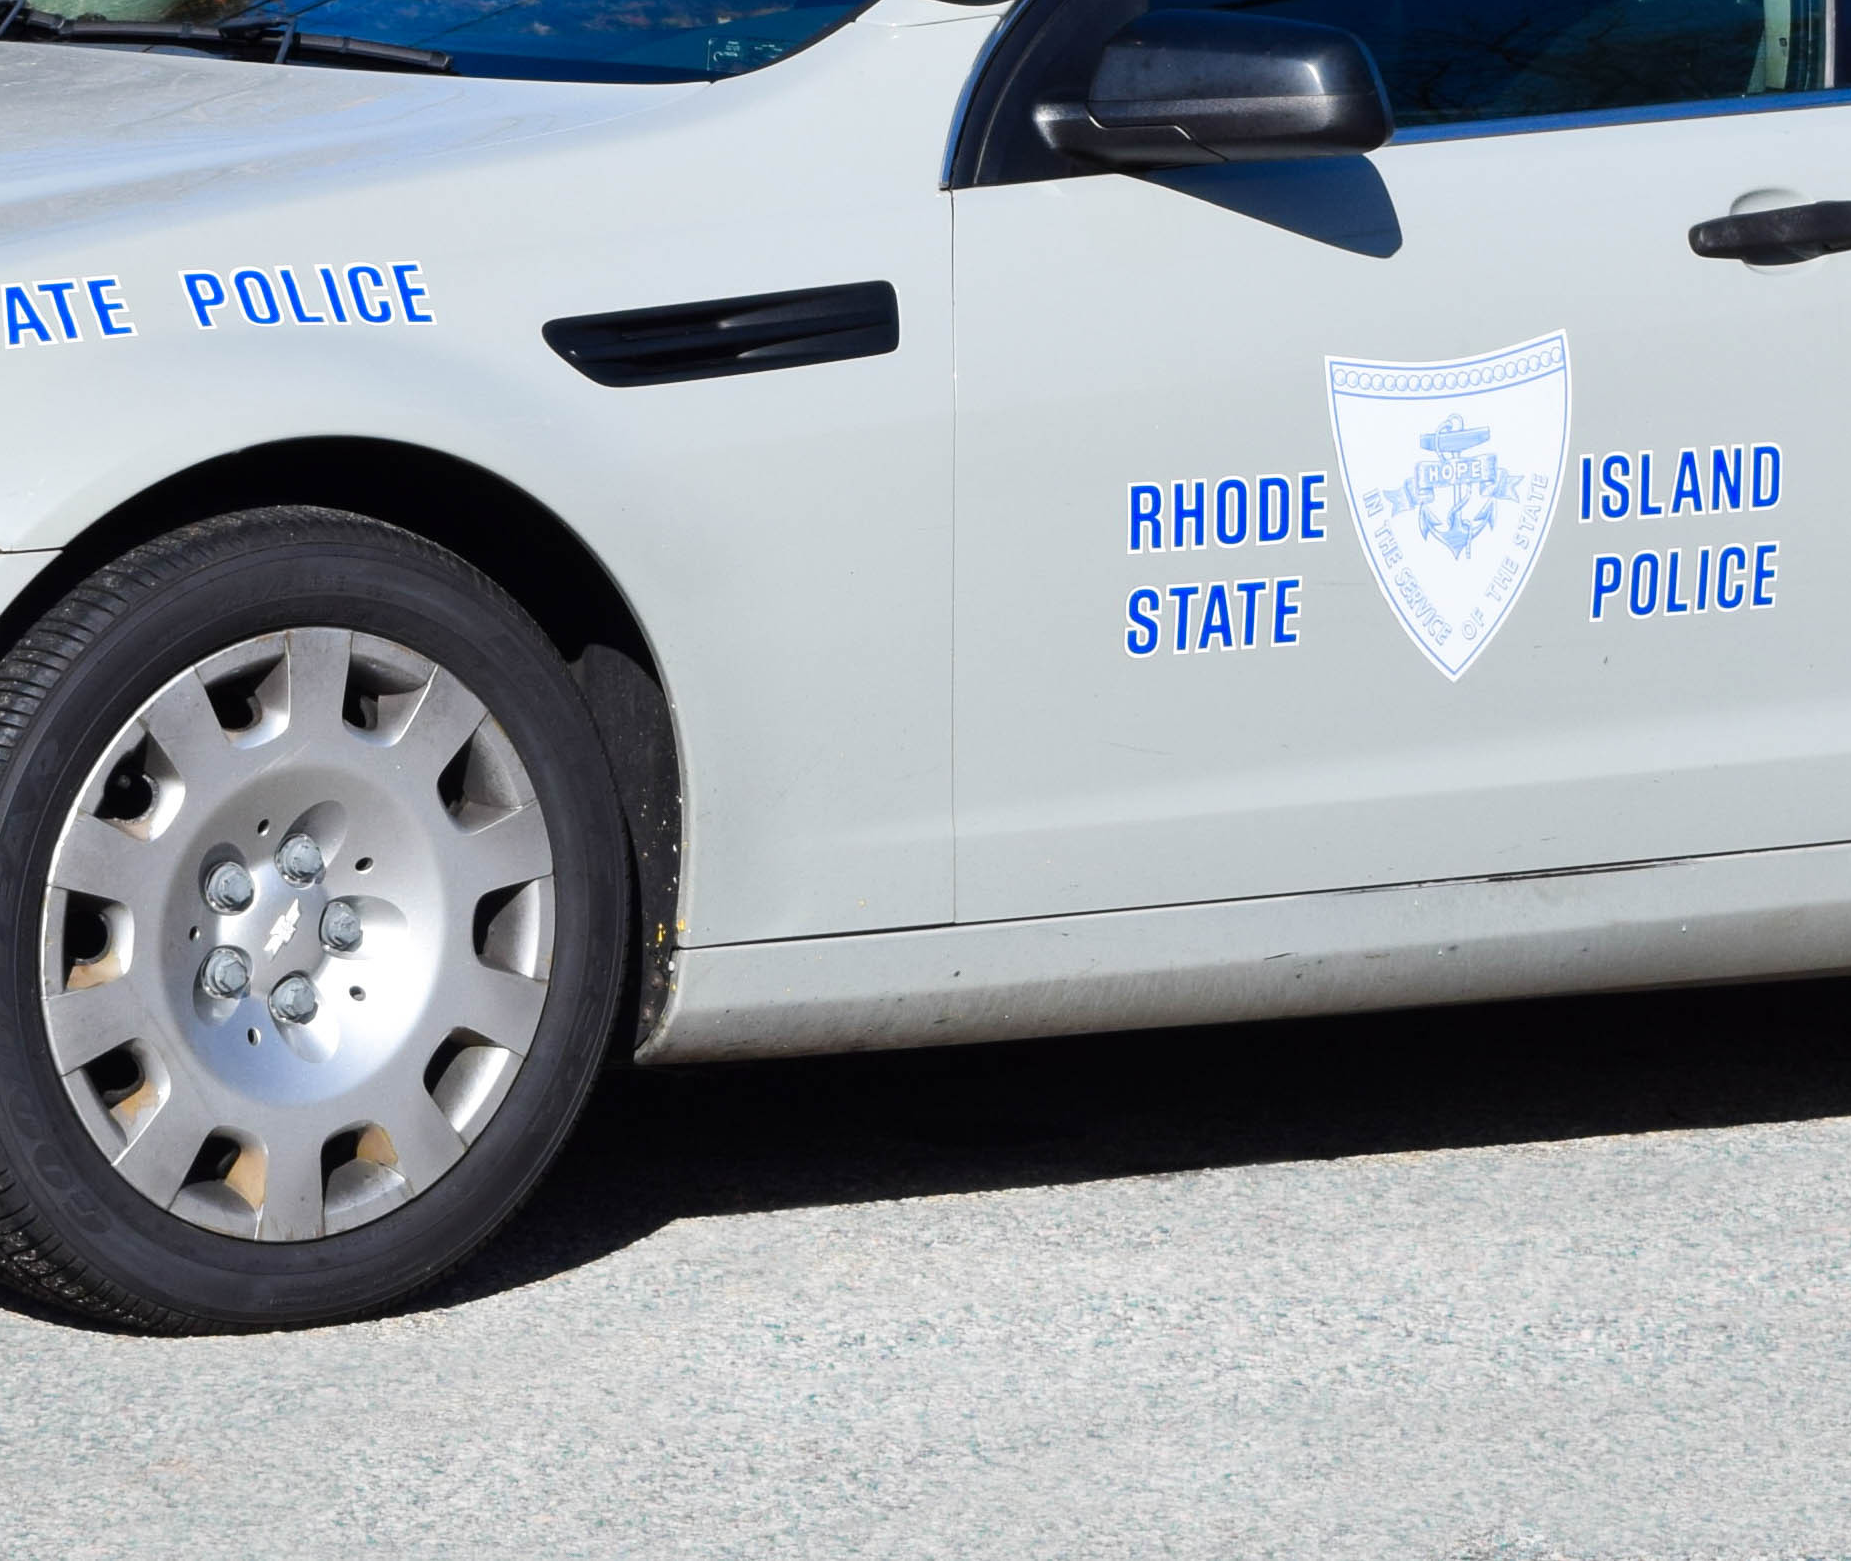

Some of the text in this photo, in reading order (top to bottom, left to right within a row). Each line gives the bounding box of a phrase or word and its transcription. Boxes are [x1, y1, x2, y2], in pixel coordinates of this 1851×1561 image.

[178, 260, 437, 329] POLICE
[1428, 459, 1483, 482] HOPE
[1579, 441, 1783, 524] ISLAND
[1126, 471, 1328, 555] RHODE
[1363, 473, 1549, 646] IN THE SERVICE OF THE STATE
[1589, 540, 1781, 623] POLICE
[1124, 575, 1303, 658] STATE
